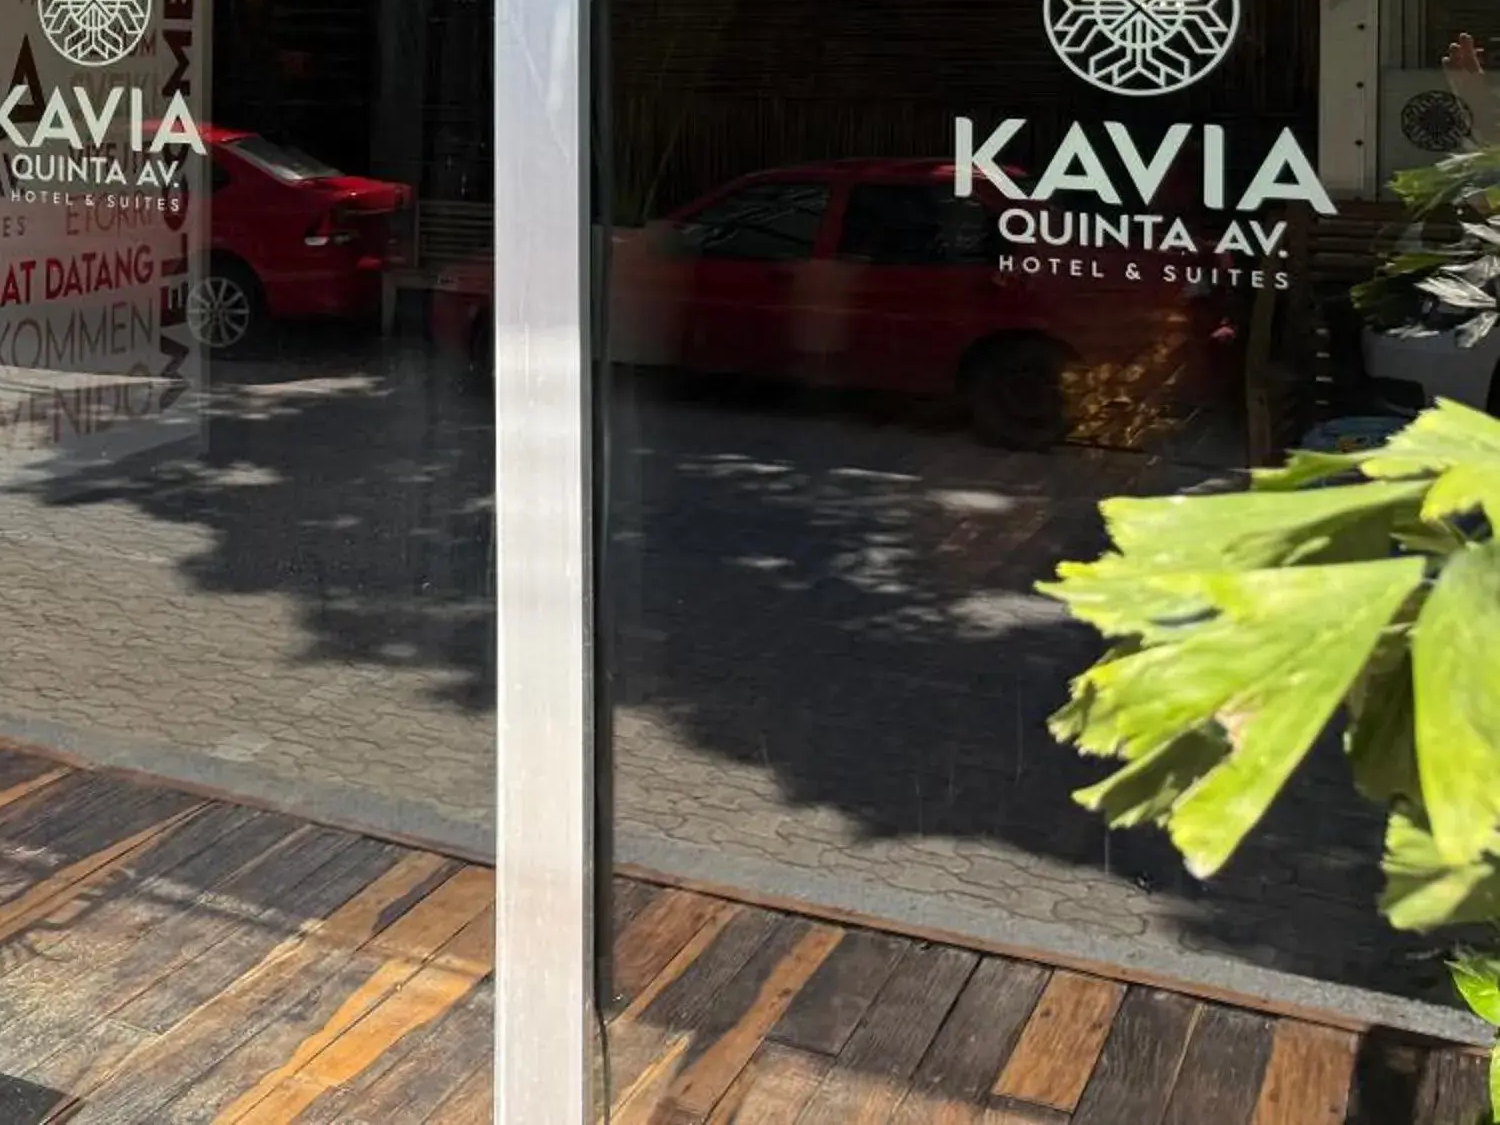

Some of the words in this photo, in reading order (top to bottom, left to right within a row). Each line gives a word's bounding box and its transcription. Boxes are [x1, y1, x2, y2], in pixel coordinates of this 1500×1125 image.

[11, 153, 127, 186] QUINTA
[136, 159, 180, 189] AV.
[954, 115, 1339, 216] KAVIA
[11, 189, 73, 207] HOTEL
[85, 193, 96, 207] &
[107, 193, 180, 213] SUITES
[998, 207, 1198, 253] QUINTA
[1215, 220, 1288, 259] AV.
[46, 244, 155, 300] DATANG
[1000, 255, 1105, 279] HOTEL
[1125, 262, 1141, 281] &
[1163, 263, 1290, 290] SUITES
